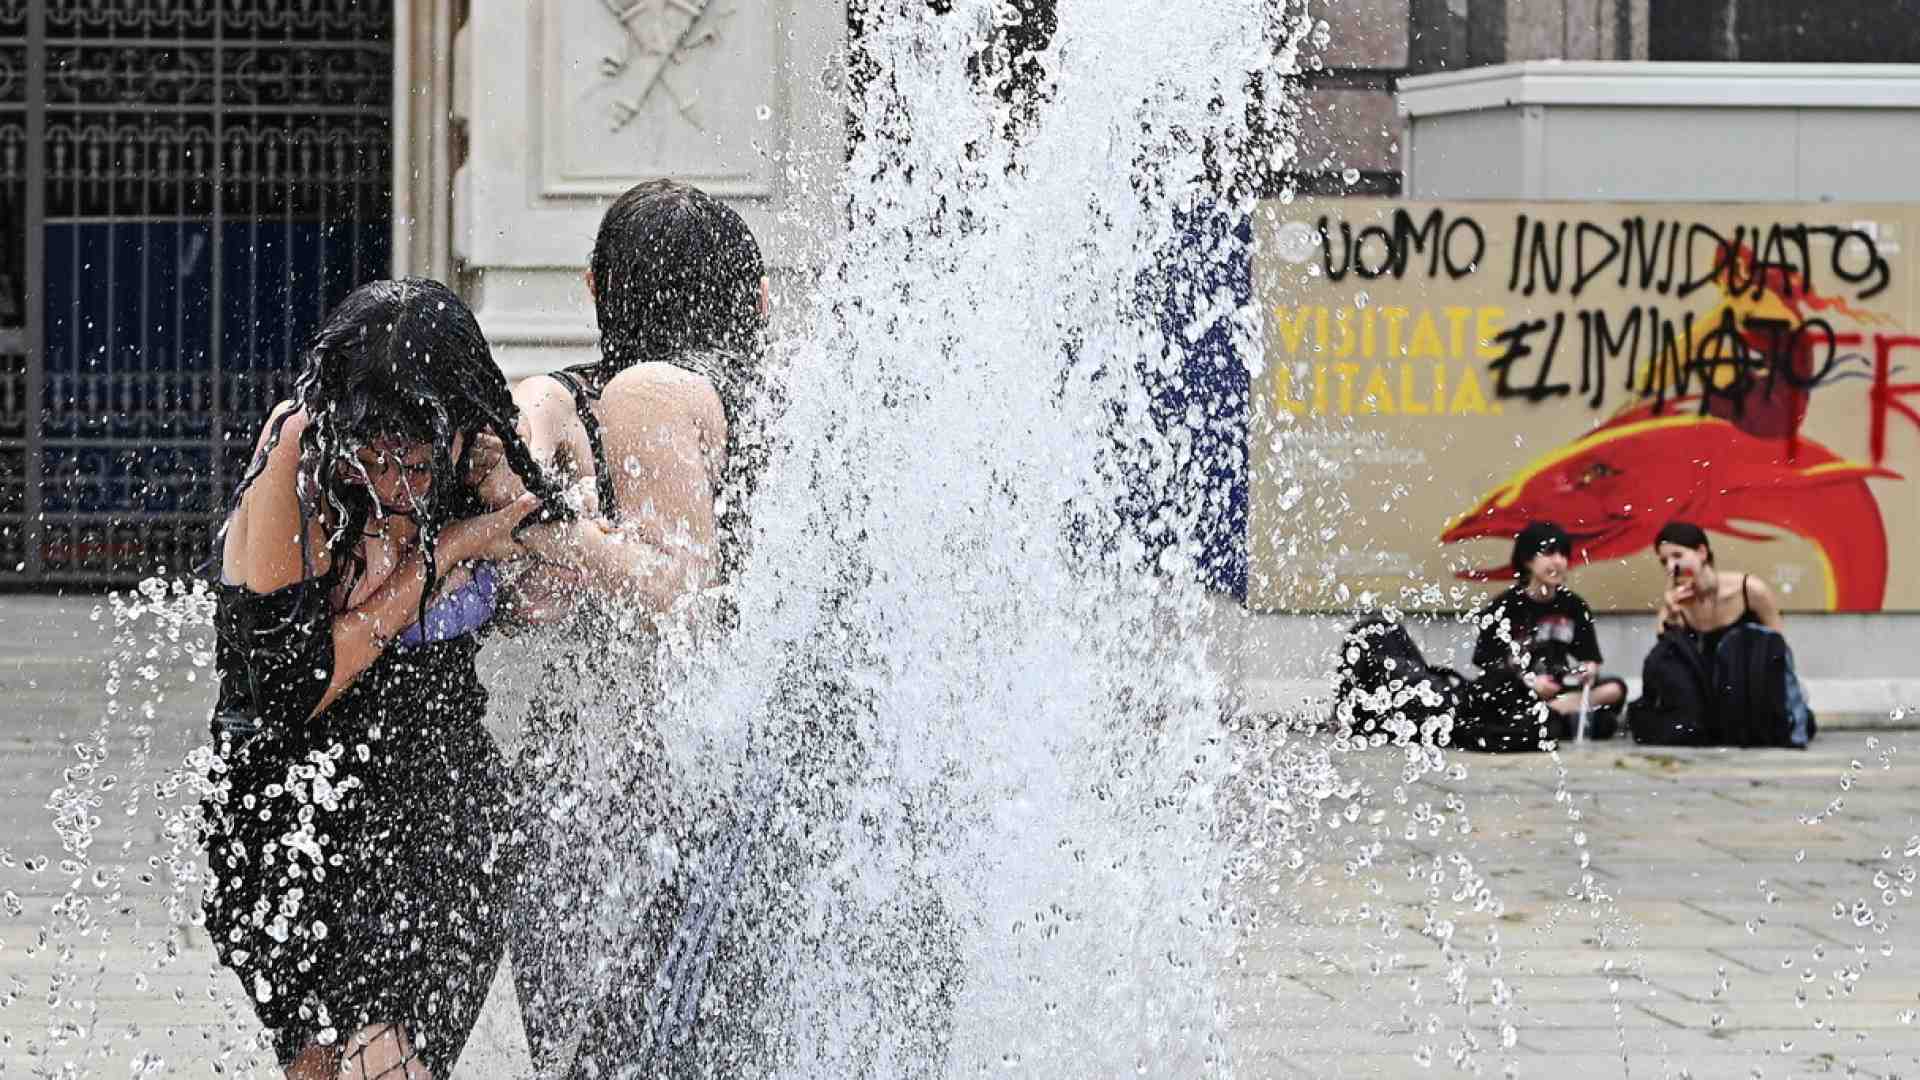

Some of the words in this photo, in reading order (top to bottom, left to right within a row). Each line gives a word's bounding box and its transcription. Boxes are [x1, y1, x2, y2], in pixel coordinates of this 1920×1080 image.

[1317, 208, 1486, 282] UOMO
[1274, 305, 1505, 358] VISITATE
[1488, 306, 1836, 417] ELIMINATO
